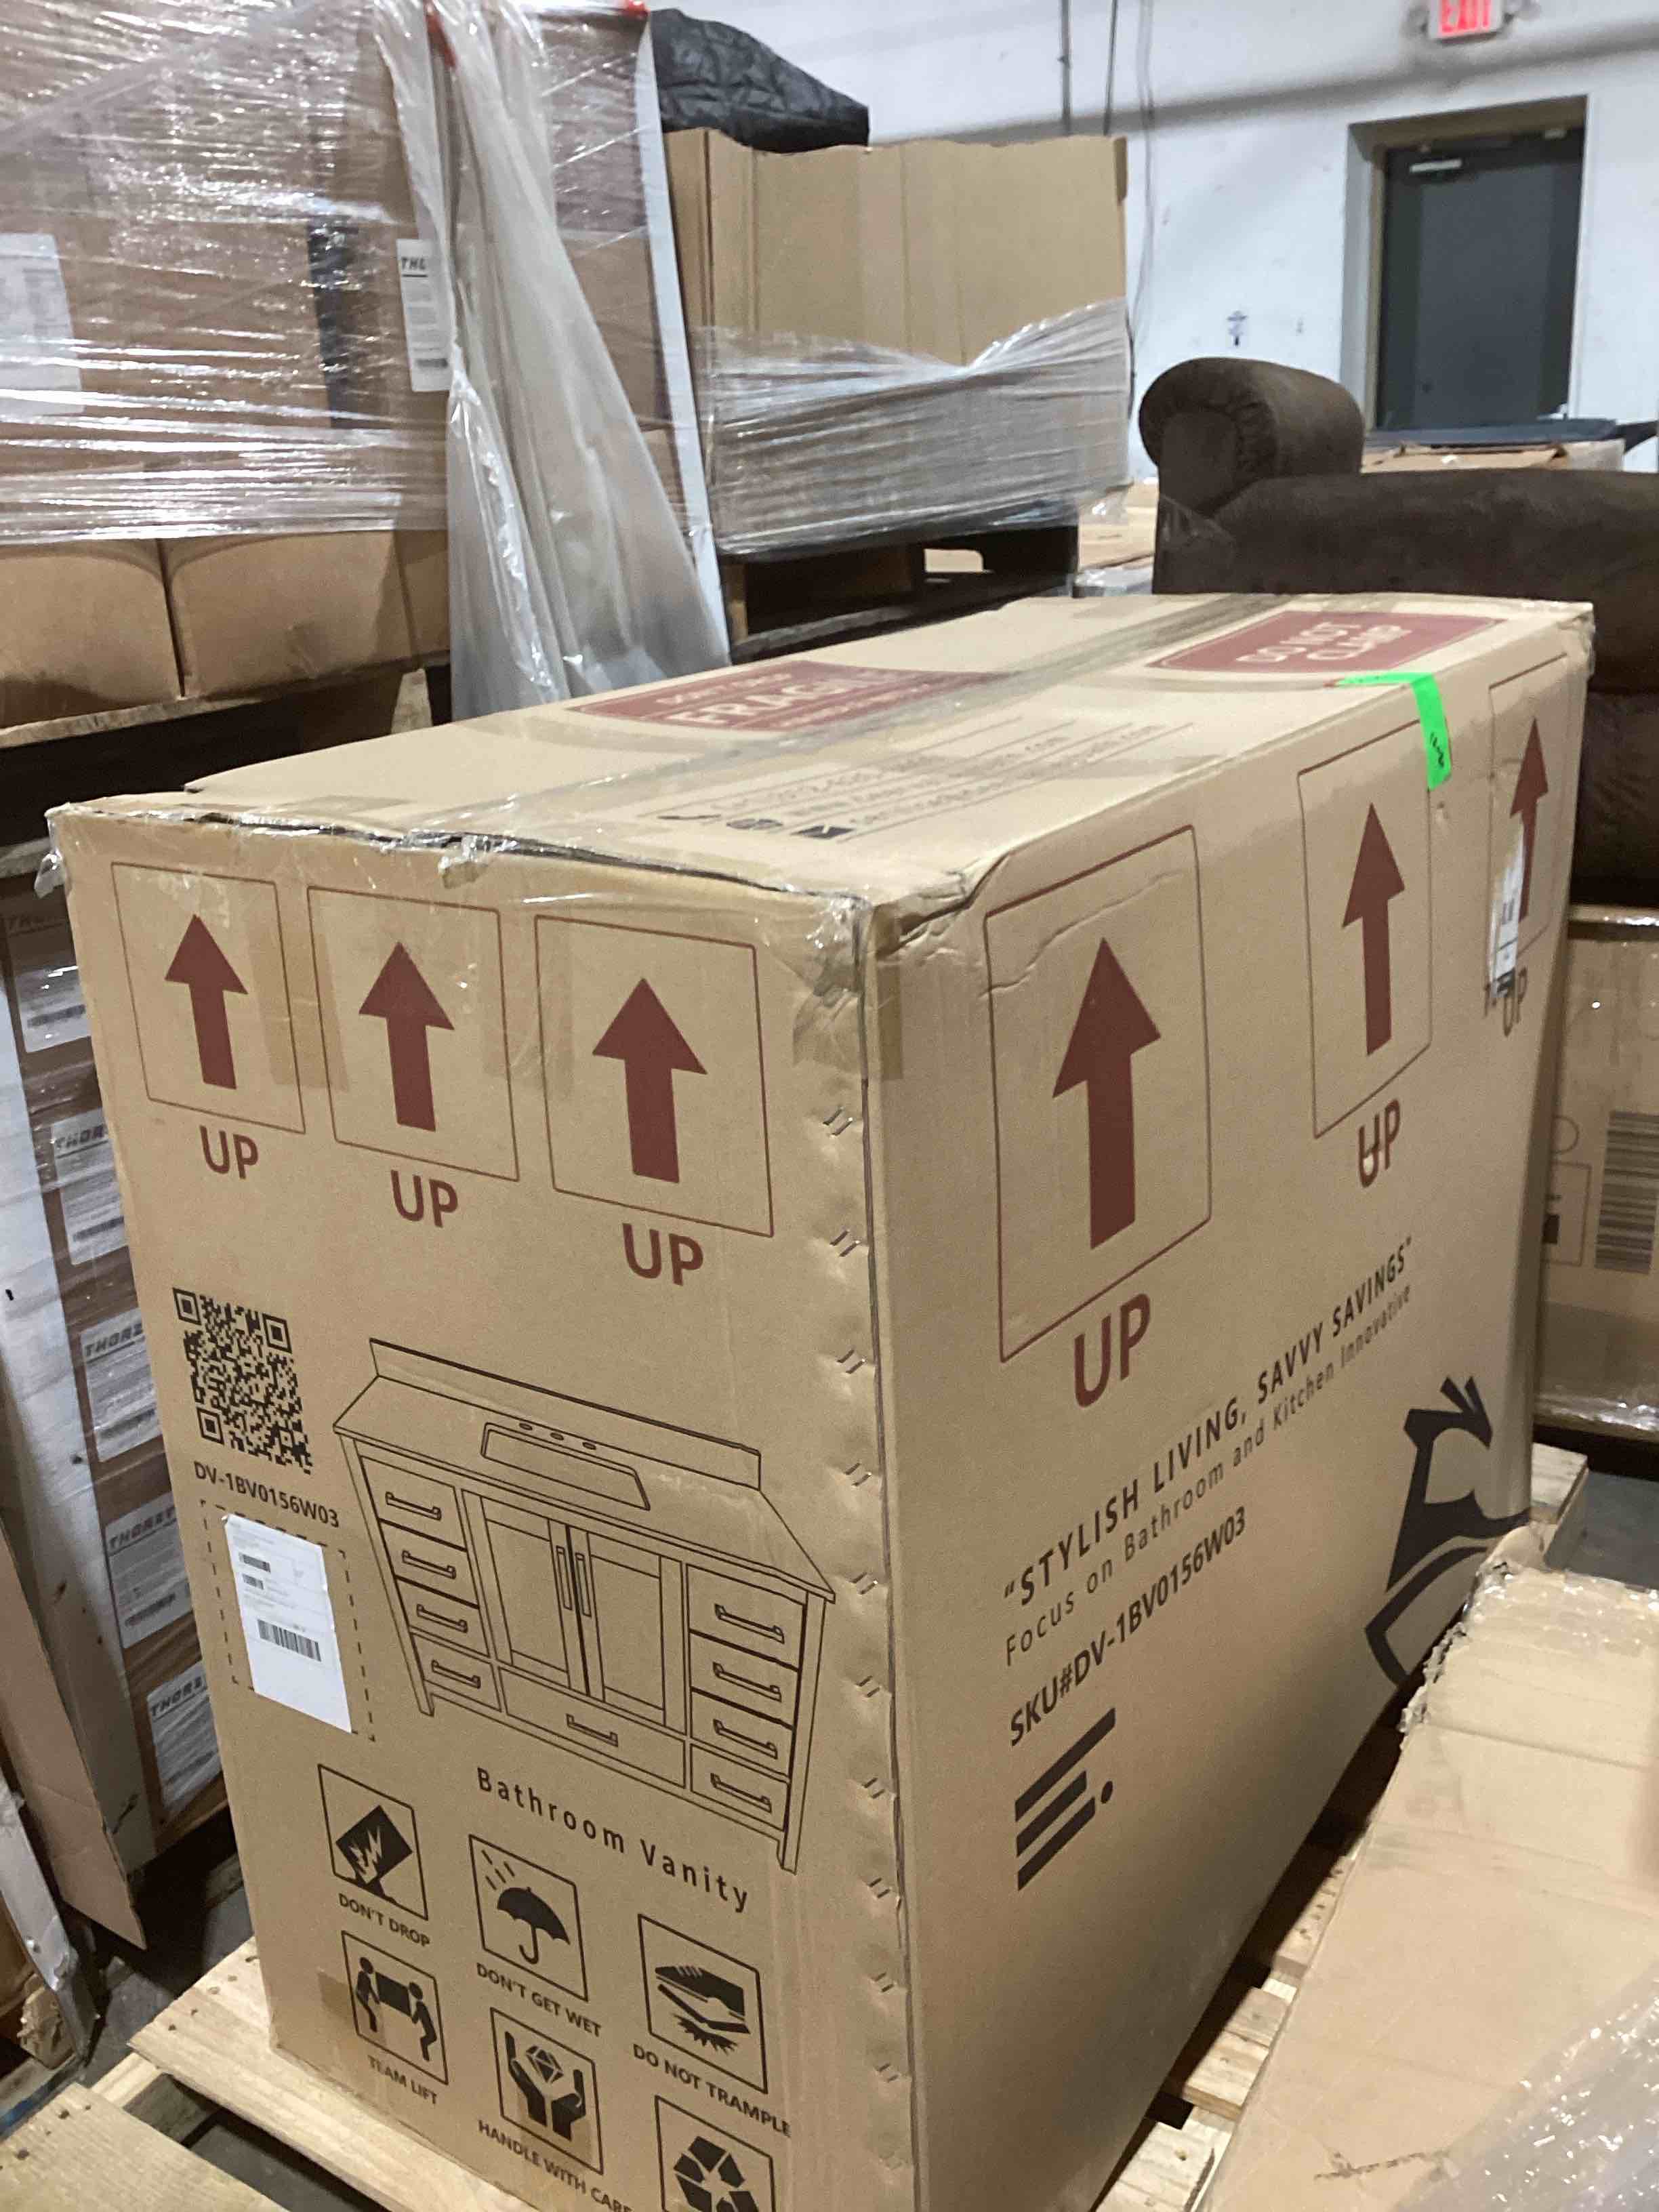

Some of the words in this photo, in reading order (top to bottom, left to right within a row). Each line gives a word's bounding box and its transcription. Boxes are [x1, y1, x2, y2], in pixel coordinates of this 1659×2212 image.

[200, 1125, 259, 1179] UP
[1358, 1099, 1401, 1188] UP
[390, 1170, 459, 1228] UP
[622, 1223, 703, 1286] UP
[1074, 1293, 1151, 1408] UP
[1154, 1397, 1246, 1494] LIVING,
[1258, 1322, 1323, 1404] SAVVY
[194, 1461, 339, 1528] DV-1BV0156W03
[1006, 1591, 1074, 1666] Focus
[1087, 1559, 1113, 1594] on
[1125, 1462, 1223, 1561] Bathroom
[1234, 1418, 1265, 1467] and
[1273, 1362, 1334, 1430] Kitchen
[1341, 1284, 1410, 1369] Innovative
[1010, 1507, 1245, 1746] SKU#DV-1BV0156W03
[477, 1767, 624, 1853] Bathroom
[640, 1839, 747, 1913] Vanity
[339, 1893, 384, 1927] DON'T
[390, 1915, 430, 1947] DROP
[477, 1963, 527, 1999] DON'T
[532, 1992, 562, 2017] GET
[565, 2010, 602, 2037] WET
[367, 2055, 408, 2089] TEAM
[411, 2078, 437, 2106] LIFT
[633, 2043, 658, 2067] DO
[665, 2062, 701, 2091] NOT
[705, 2081, 792, 2137] TRAMPLE
[478, 2119, 540, 2167] HANDLE
[544, 2159, 586, 2195] WITH
